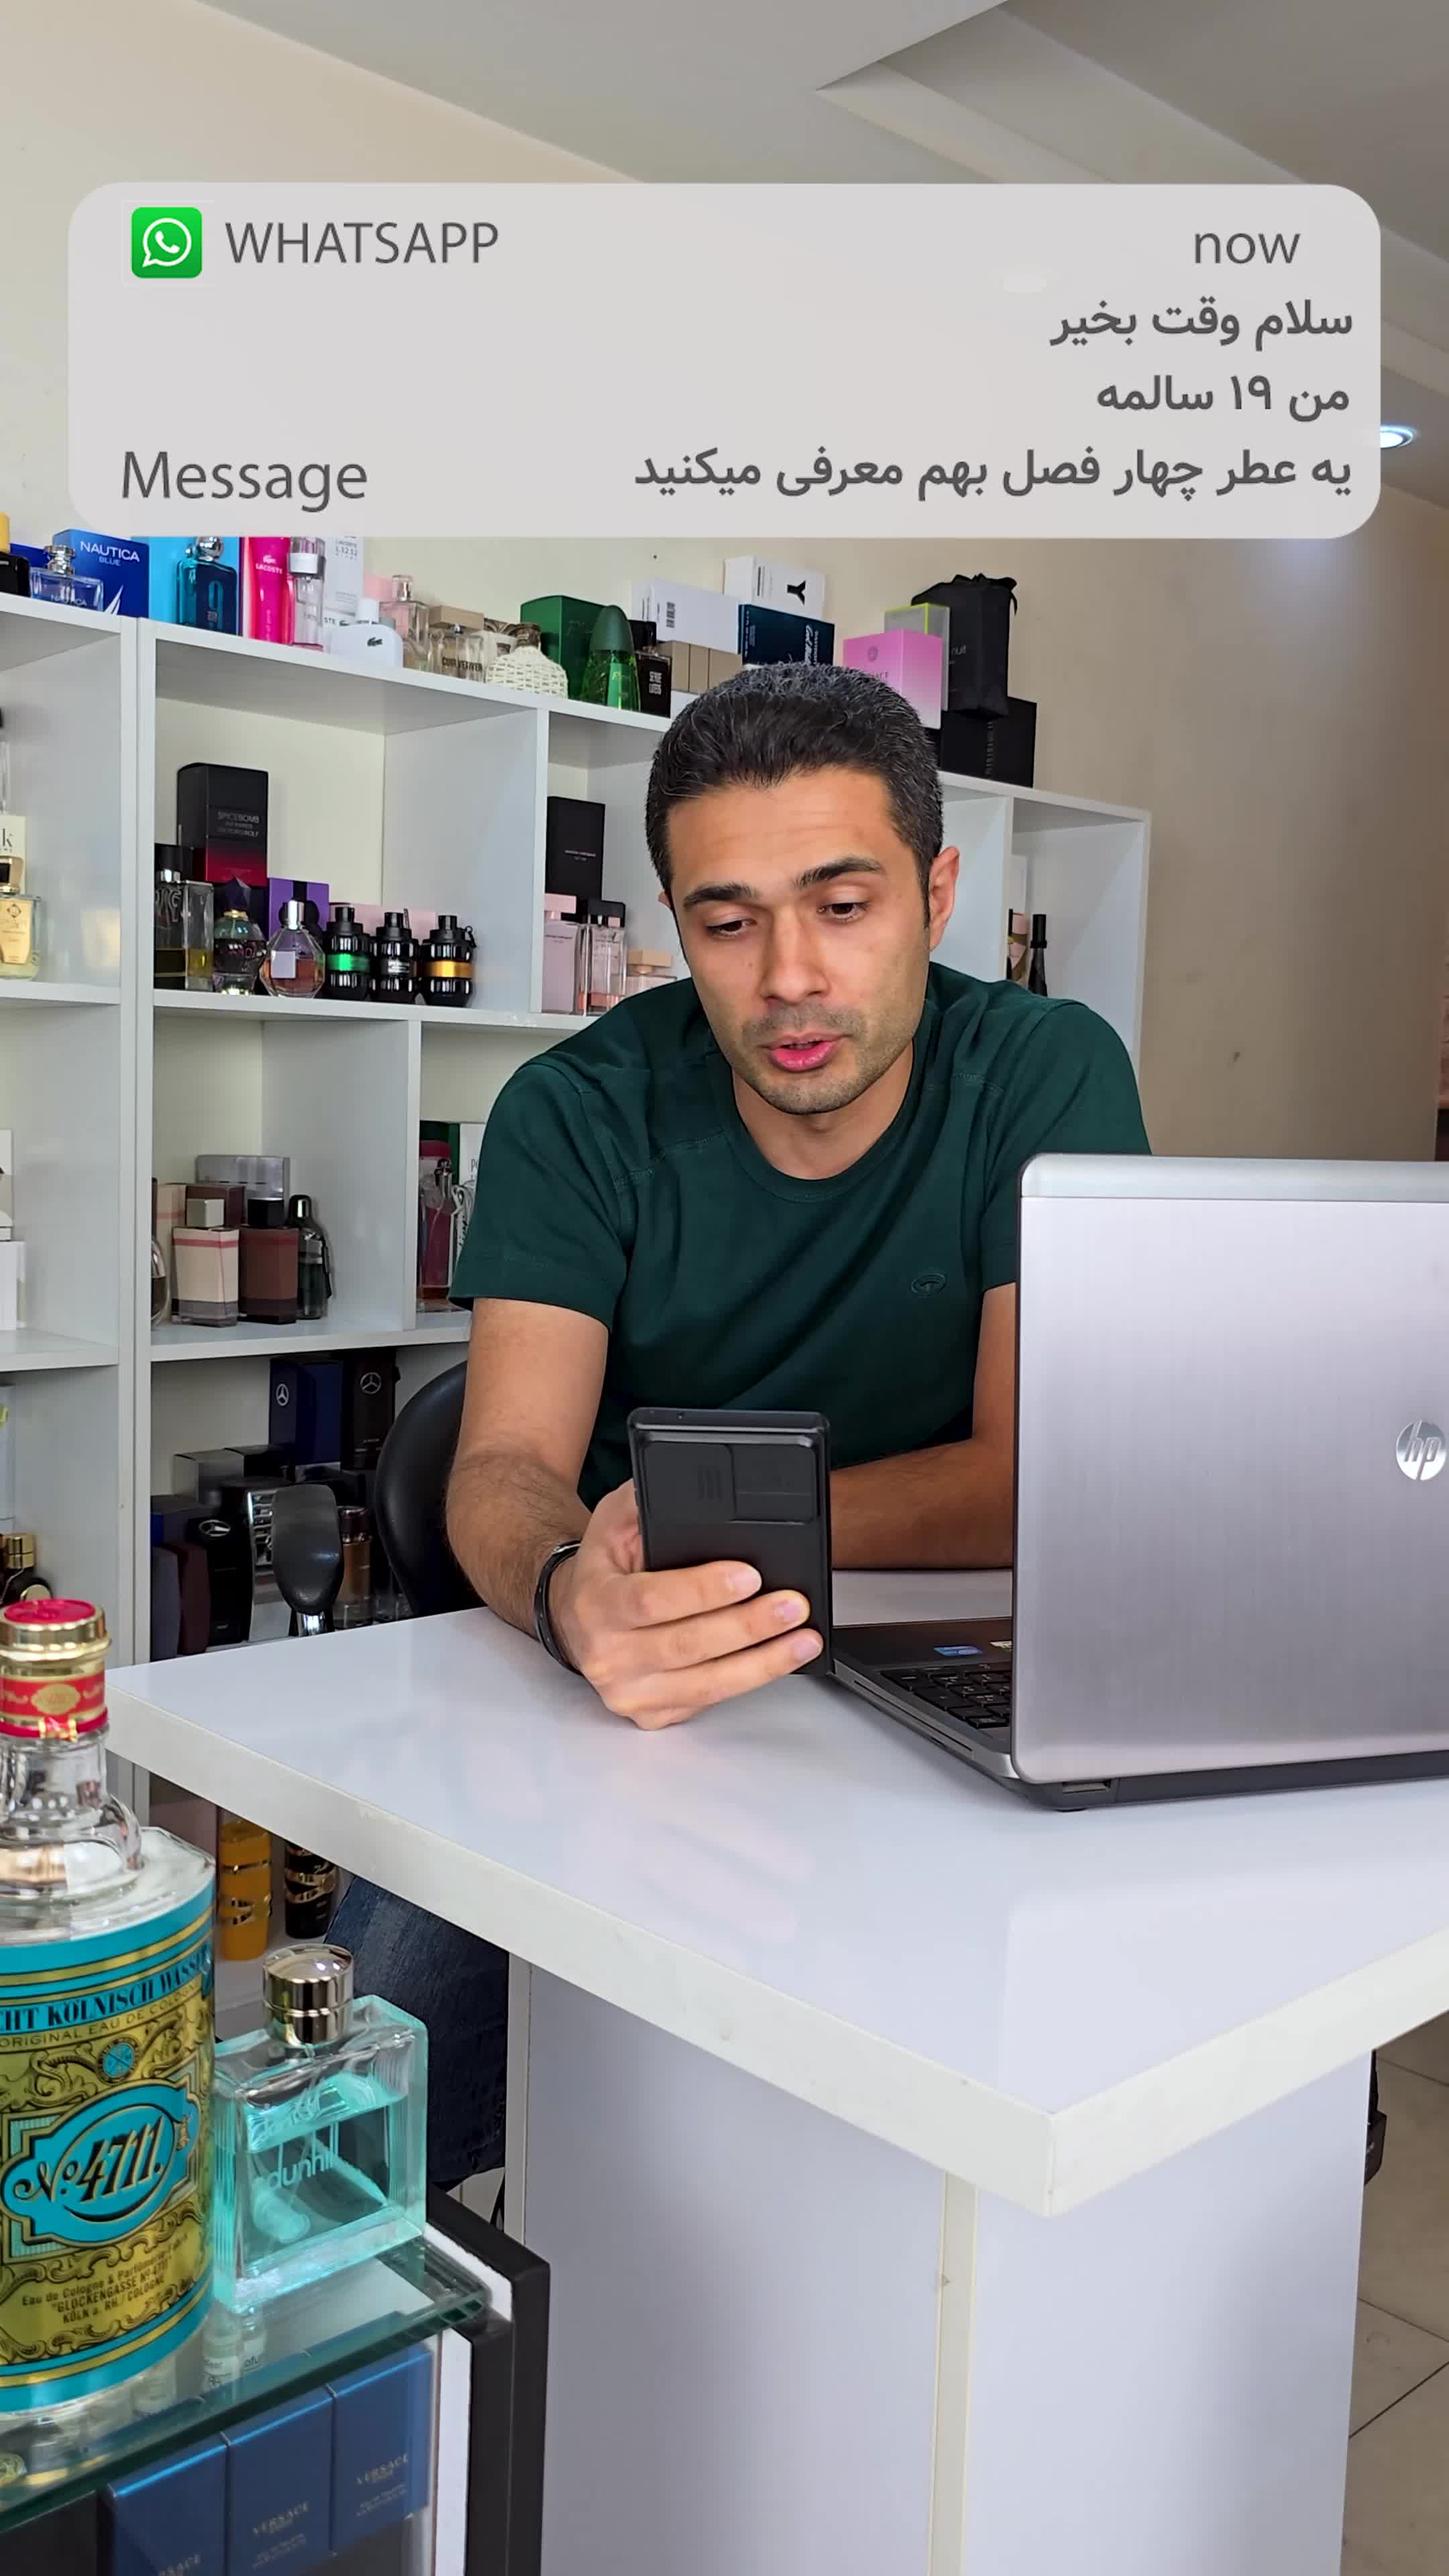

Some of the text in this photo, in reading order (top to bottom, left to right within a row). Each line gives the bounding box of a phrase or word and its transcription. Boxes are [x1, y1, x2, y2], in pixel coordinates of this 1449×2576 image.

[80, 541, 140, 563] NAUTICA
[99, 557, 121, 567] BLUE
[255, 562, 283, 575] LACOSTE
[1402, 1417, 1442, 1481] hp
[0, 2006, 40, 2031] HT
[0, 2029, 82, 2048] ORIGINAL
[88, 2018, 120, 2035] EAU
[126, 2011, 146, 2025] DE
[268, 2120, 339, 2191] dunhill
[22, 2295, 42, 2306] Eau
